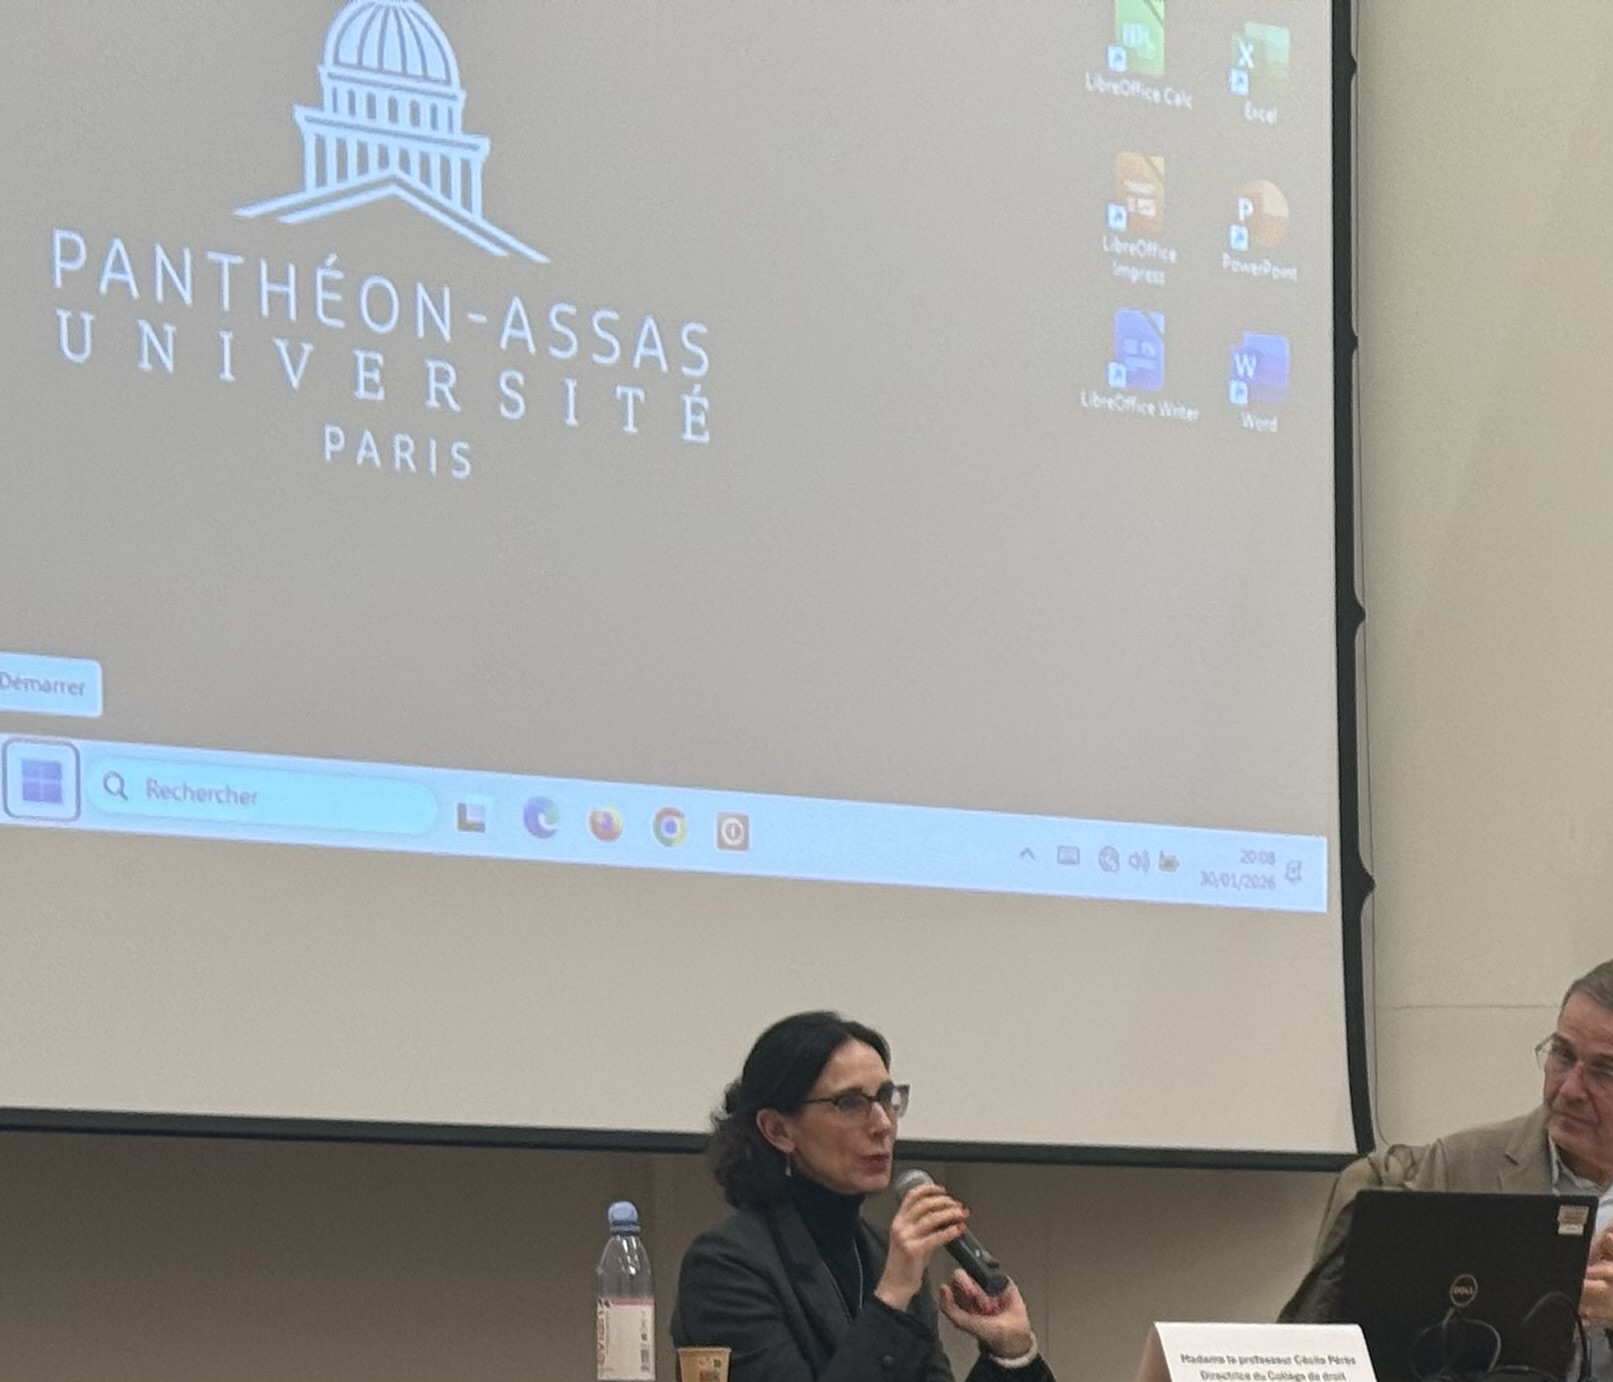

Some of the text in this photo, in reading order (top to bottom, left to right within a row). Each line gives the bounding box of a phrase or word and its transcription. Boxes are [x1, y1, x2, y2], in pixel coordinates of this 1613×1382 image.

[1085, 73, 1193, 109] LibreOffice Calc
[1244, 101, 1278, 124] Excel
[1103, 236, 1178, 263] LibreOffice
[1221, 252, 1297, 282] PowerPoint
[52, 228, 711, 379] PANTHÉON-ASSAS
[56, 308, 711, 443] UNIVERSITÉ
[1081, 390, 1200, 421] LibreOffice Writer
[1241, 412, 1278, 433] Word
[323, 424, 473, 479] PARIS
[0, 671, 86, 697] Démarrer
[145, 777, 258, 807] Rechercher
[1180, 1353, 1226, 1365] Madame
[1239, 1354, 1293, 1367] professeur
[1200, 1370, 1252, 1382] Directrice
[1322, 1371, 1347, 1382] droit
